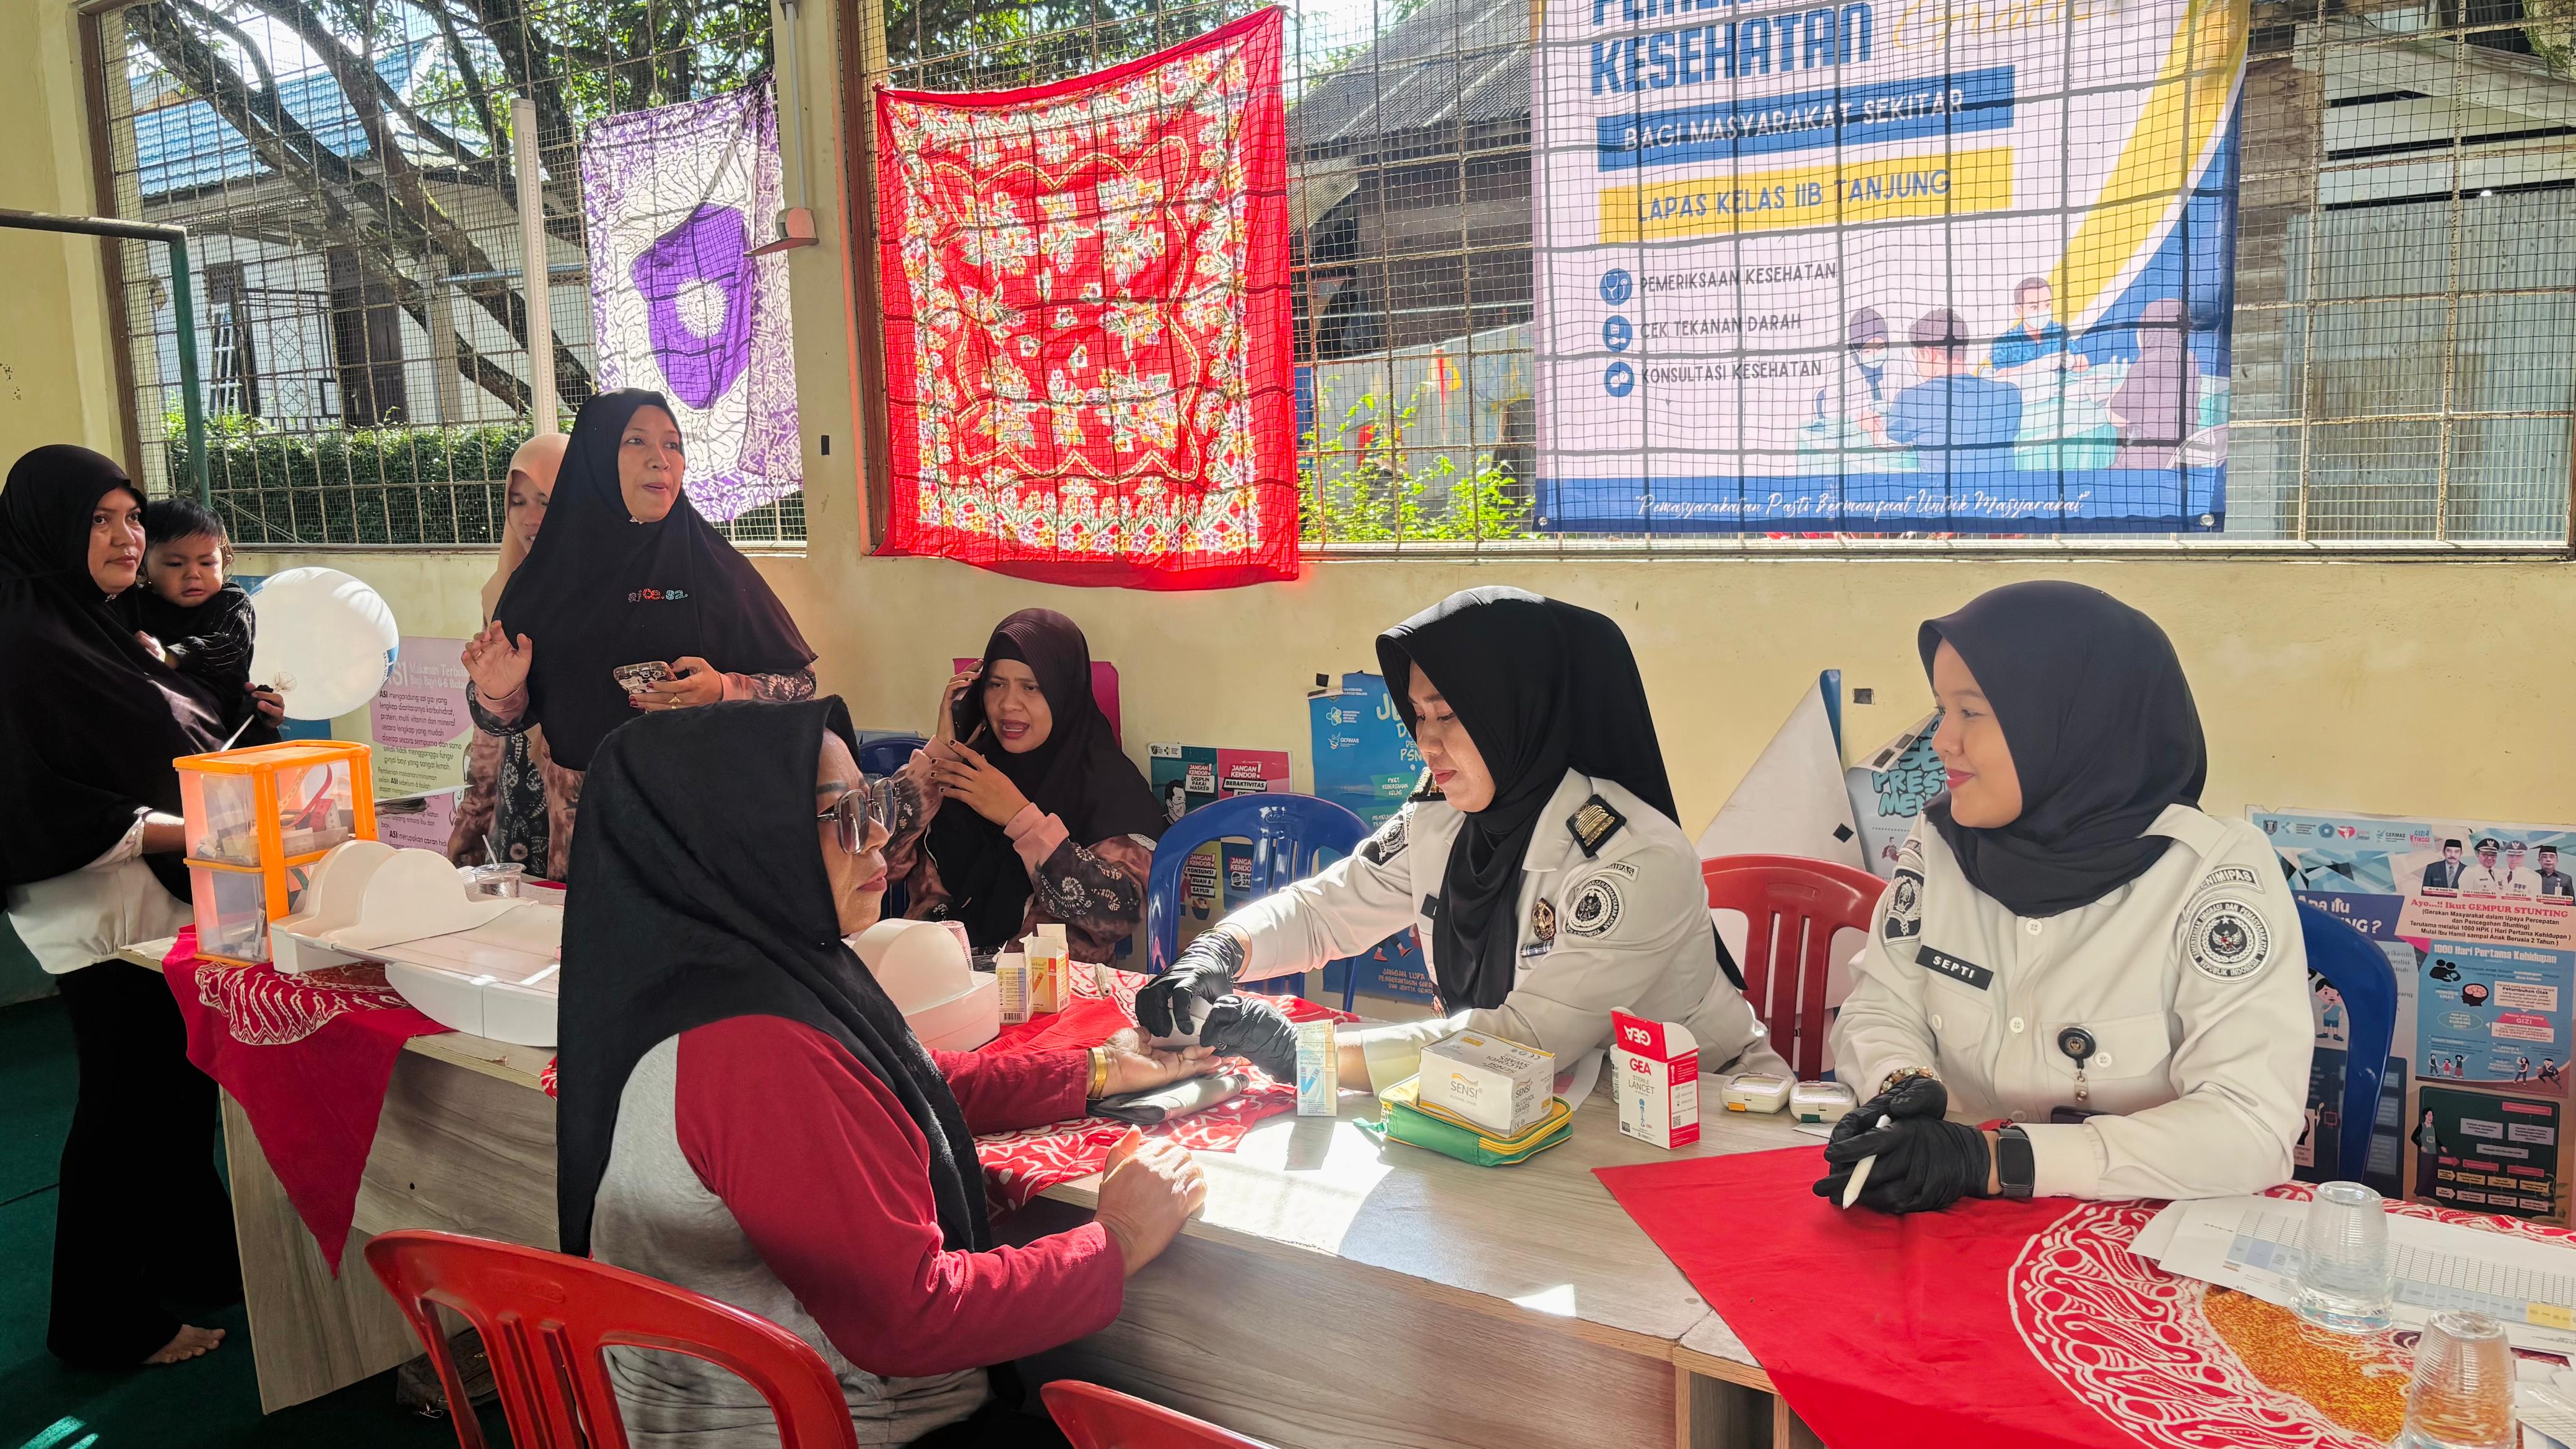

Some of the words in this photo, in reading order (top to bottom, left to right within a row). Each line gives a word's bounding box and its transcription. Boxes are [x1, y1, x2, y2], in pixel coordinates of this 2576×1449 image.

[1591, 2, 1873, 95] KESEHATAN
[1624, 122, 1681, 151] BAGI
[1689, 102, 1852, 144] MASYARAKAT
[1863, 88, 1964, 125] SEKITAR
[1638, 194, 1707, 222] LAPAS
[1716, 185, 1785, 215] KELAS
[1796, 182, 1822, 207] IIB
[1834, 168, 1951, 204] TANJUNG
[1640, 269, 1739, 292] PEMERIKSAAN
[1746, 262, 1837, 285] KESEHATAN
[1640, 321, 1668, 339] CEK
[1673, 316, 1742, 336] TEKANAN
[1748, 313, 1801, 332] DARAH
[1640, 364, 1726, 384] KONSULTASI
[1733, 360, 1822, 380] KESEHATAN
[1765, 492, 1812, 518] Pasti
[1816, 492, 1916, 521] Bermanfaat
[1917, 489, 1969, 513] Untuk
[385, 661, 409, 687] SI
[379, 690, 388, 698] ASI
[391, 777, 399, 785] ASI
[1225, 780, 1264, 788] BERAKTIVITAS
[389, 830, 398, 838] ASI
[2331, 898, 2350, 914] itu
[2445, 901, 2466, 910] Ikut
[2468, 903, 2512, 913] GEMPUR
[2514, 907, 2569, 918] STUNTING
[2422, 908, 2449, 916] (Gerakan
[2450, 911, 2484, 920] Masyarakat
[2525, 916, 2560, 926] Percepatan
[2465, 918, 2502, 928] Pencegahan
[2502, 920, 2530, 930] Stunting)
[2410, 920, 2437, 928] Terutama
[2509, 928, 2533, 936] Pertama
[2535, 931, 2567, 940] Kehidupan
[2467, 932, 2489, 941] sampai
[2536, 938, 2555, 946] Tahun
[2434, 944, 2453, 954] 1000
[2455, 944, 2473, 955] Hari
[2474, 947, 2512, 959] Pertama
[2513, 950, 2557, 964] Kehidupan
[1382, 968, 1408, 978] JANGAN
[1409, 972, 1425, 981] LUPA
[1932, 955, 1975, 980] SEPTI
[2198, 959, 2229, 977] REPUBLIK
[2229, 958, 2261, 977] INDONESIA
[1624, 1025, 1651, 1046] GEA
[1486, 1055, 1525, 1070] ALCOHOL
[1629, 1058, 1651, 1076] GEA
[1628, 1081, 1655, 1095] LANCET
[1632, 1075, 1650, 1085] STERILE
[1450, 1081, 1478, 1099] SENSI
[1450, 1094, 1465, 1103] ALCOHOL
[1515, 1084, 1531, 1099] SENSI
[1515, 1093, 1535, 1109] ALCOHOL
[1515, 1102, 1530, 1115] SWABS
